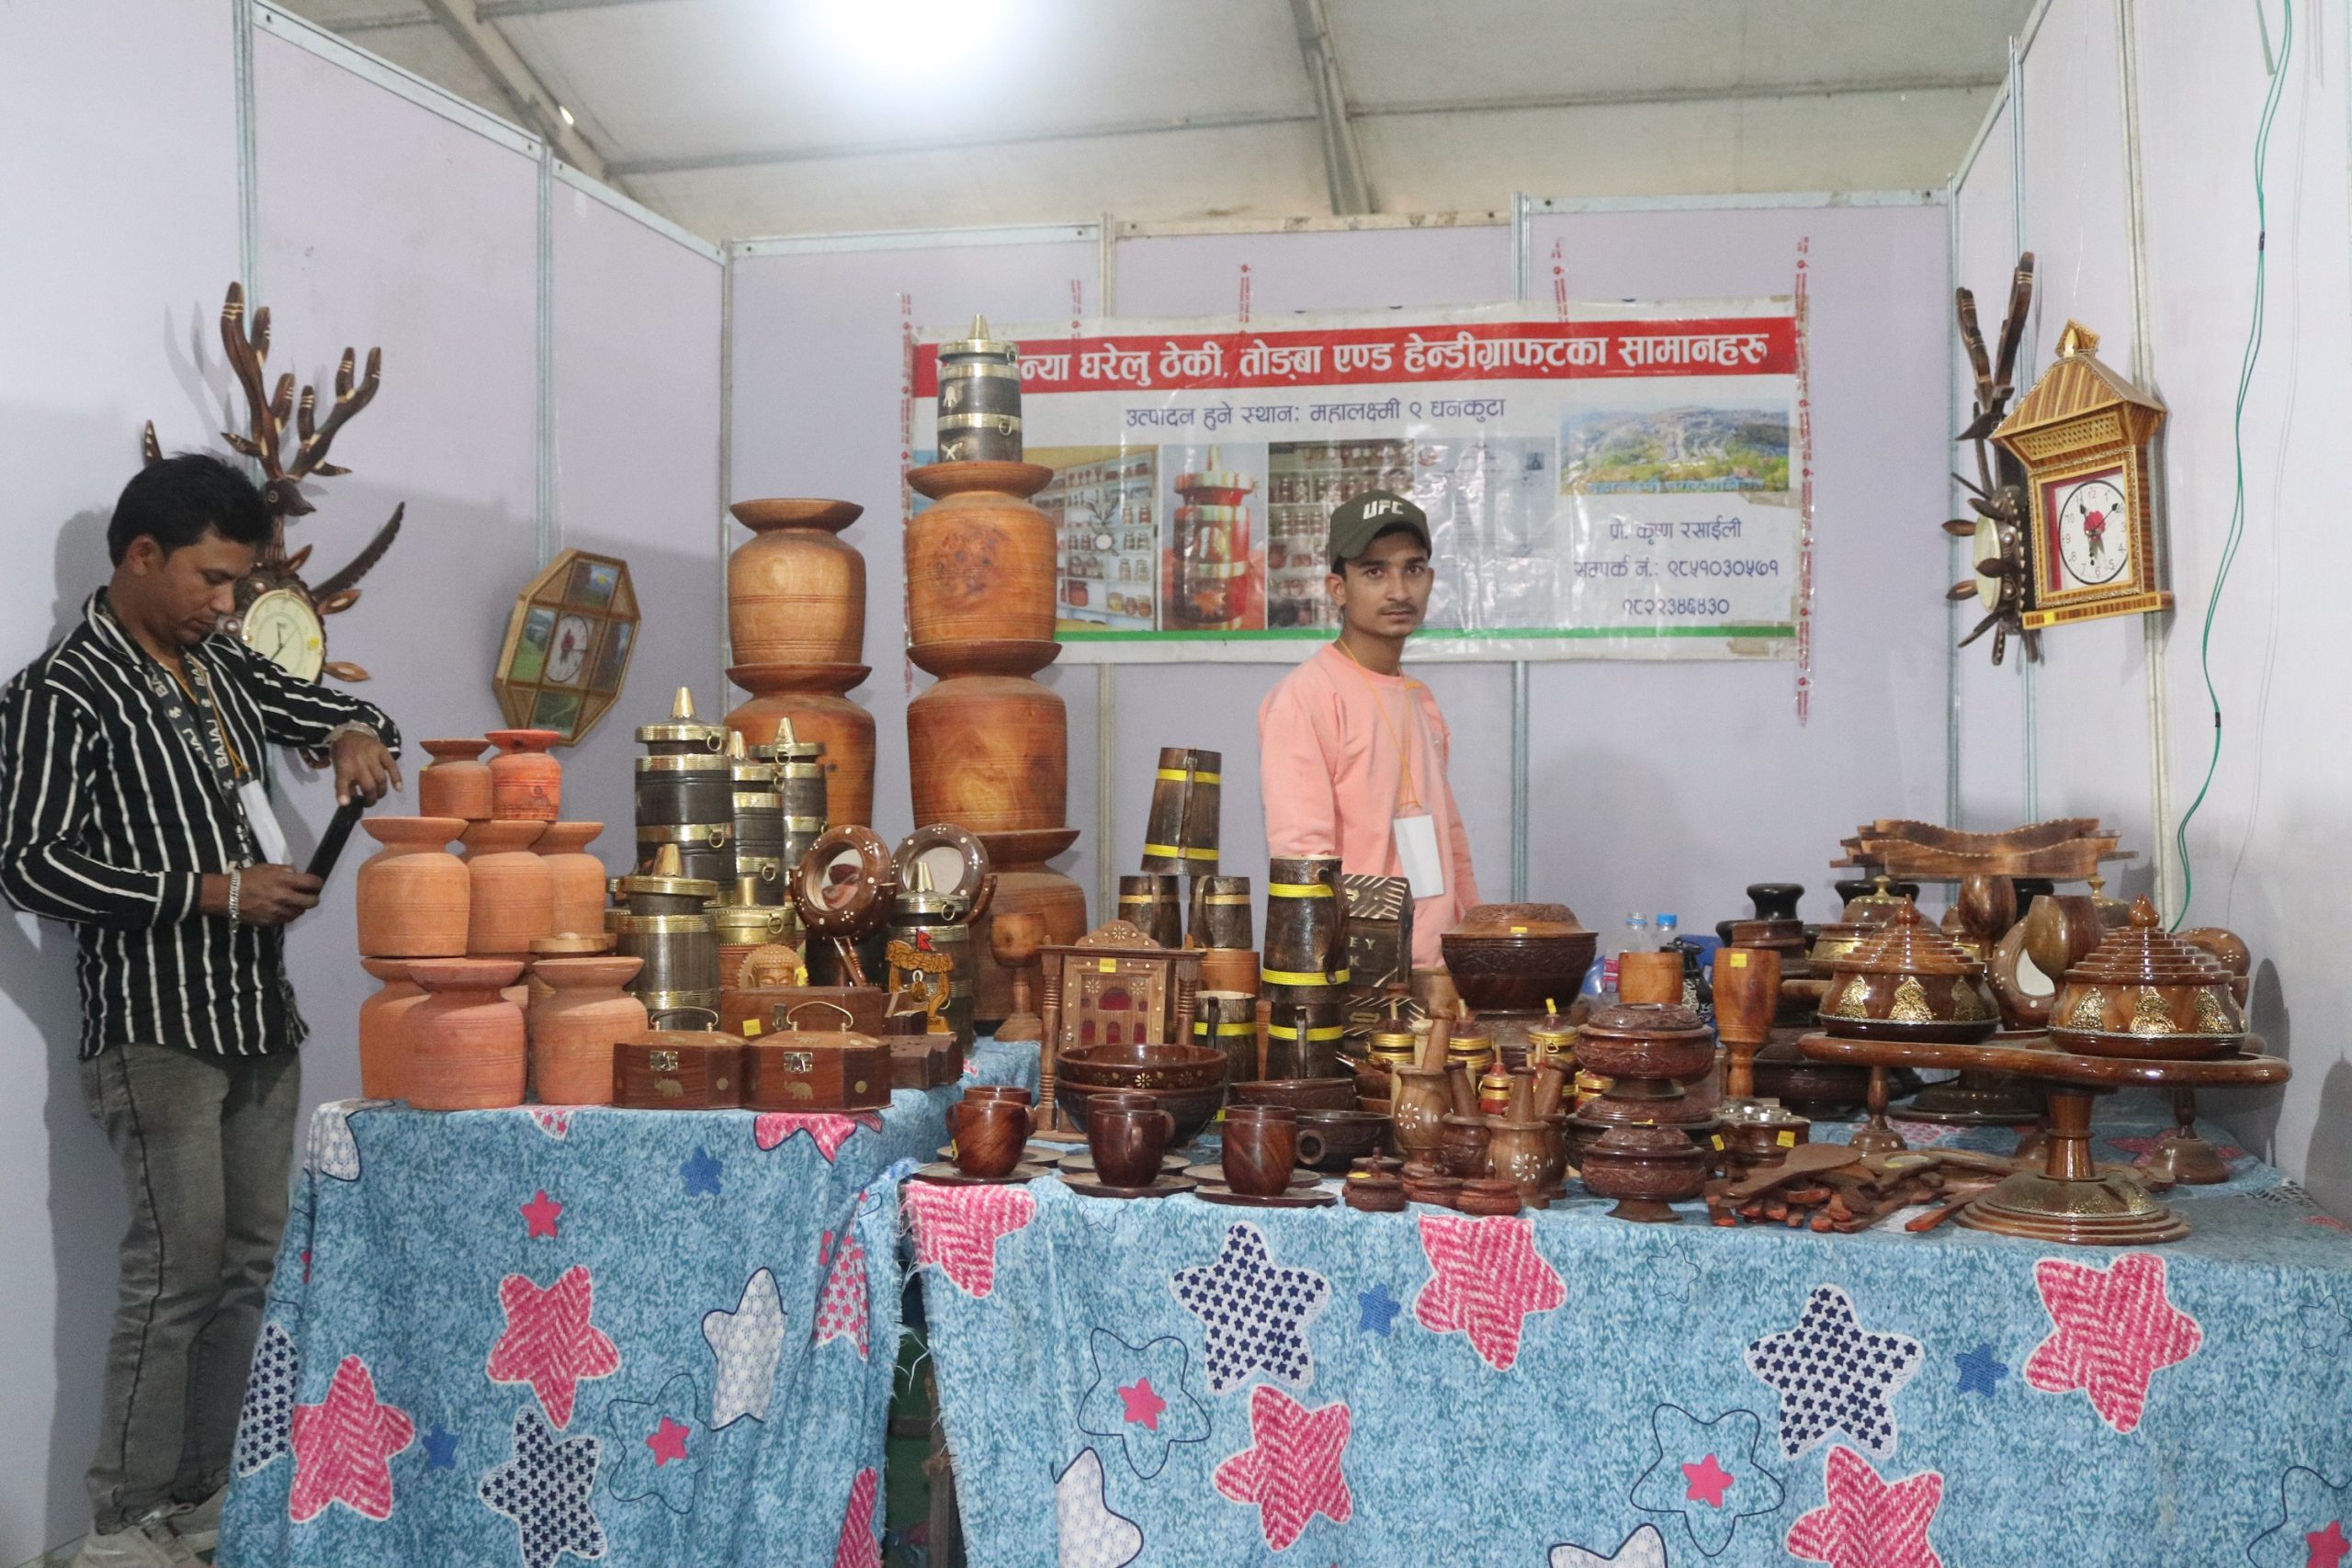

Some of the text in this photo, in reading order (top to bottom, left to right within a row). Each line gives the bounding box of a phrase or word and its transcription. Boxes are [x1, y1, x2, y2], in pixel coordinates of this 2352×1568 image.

[1080, 343, 1151, 386] घरेलु
[1332, 344, 1396, 373] एण्ड
[1126, 408, 1194, 427] उत्पादन
[1204, 401, 1234, 430] हुने
[1310, 398, 1401, 423] महालक्ष्मी
[1363, 499, 1404, 520] UFC
[1635, 522, 1673, 546] कृष्ण
[1680, 515, 1743, 539] रसाईली
[206, 718, 230, 770] BAJAJ
